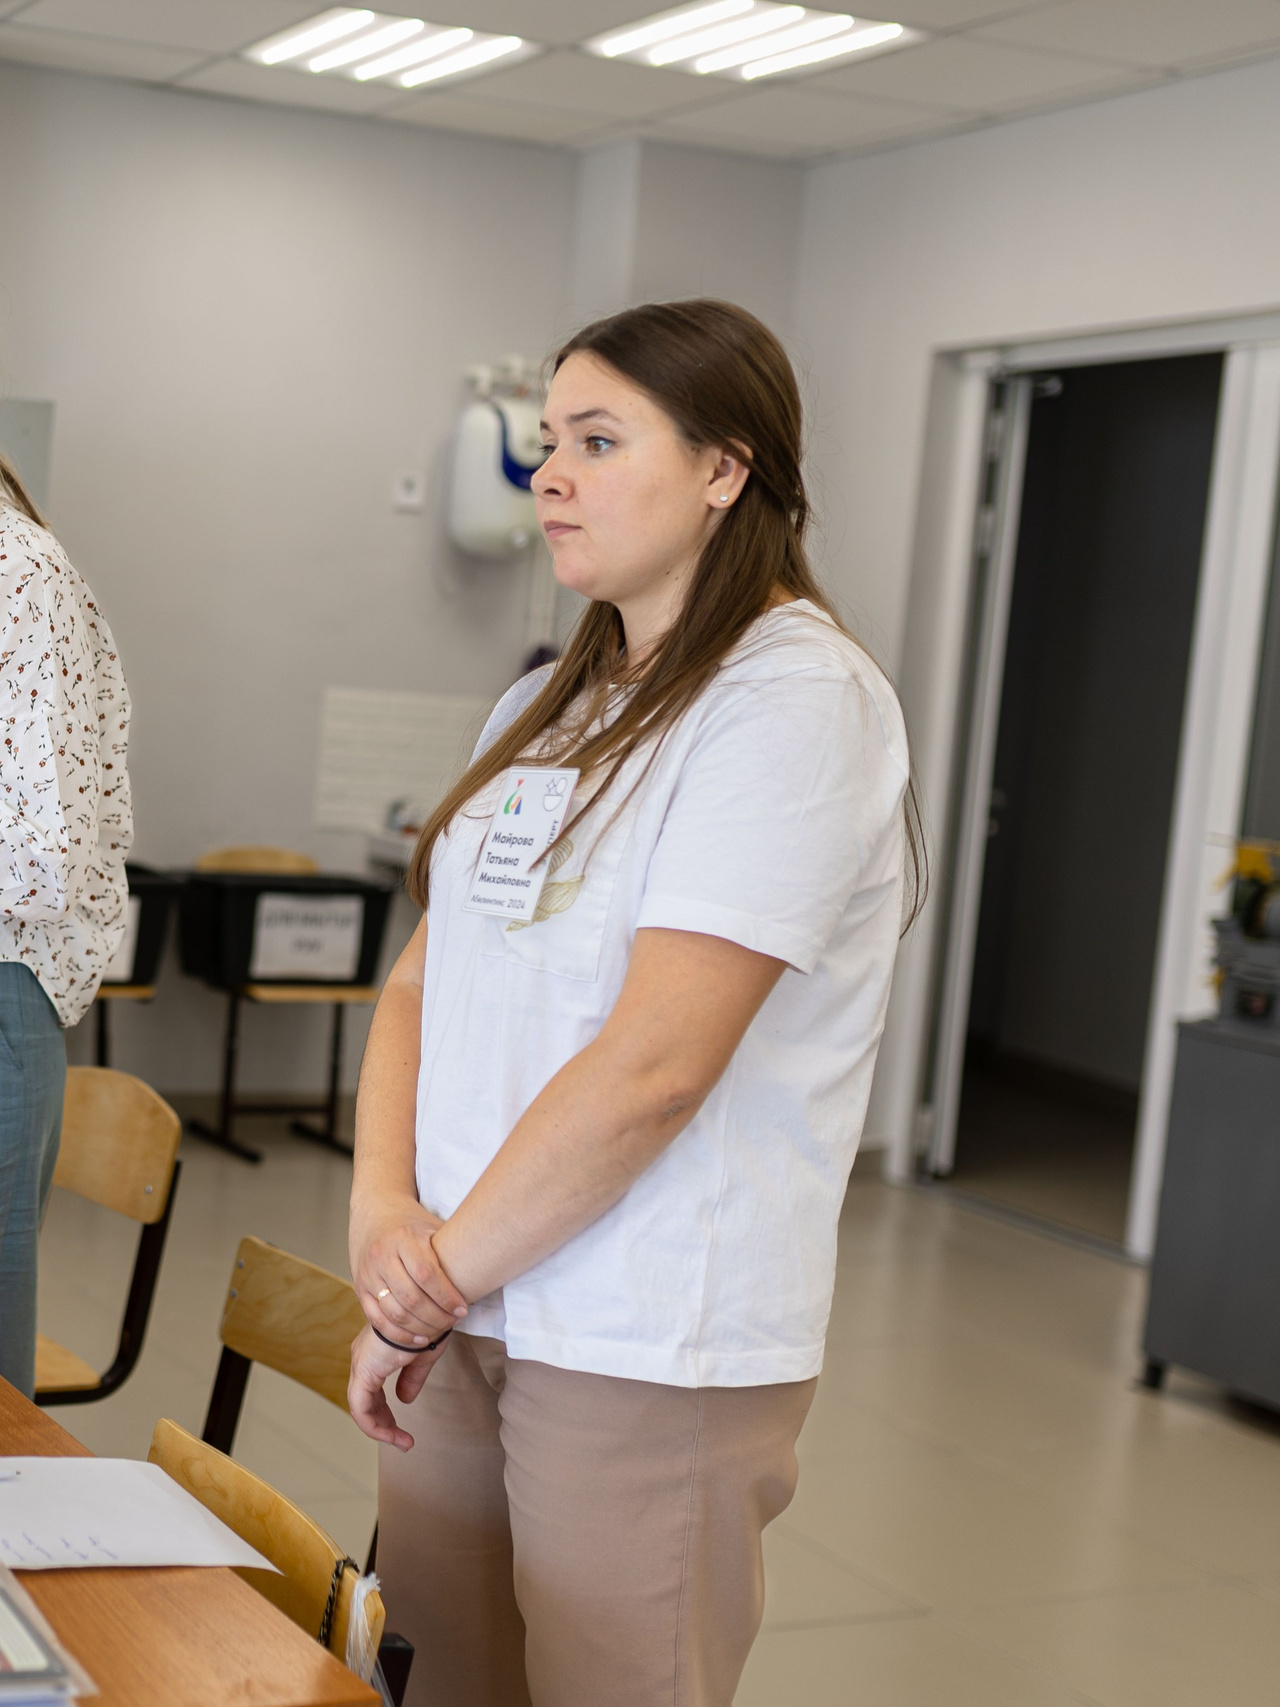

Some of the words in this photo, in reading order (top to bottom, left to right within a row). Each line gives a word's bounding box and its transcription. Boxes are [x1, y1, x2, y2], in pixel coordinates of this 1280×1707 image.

[492, 832, 534, 848] Майрова
[485, 852, 519, 866] Татьяна
[478, 872, 532, 888] Михайловна
[507, 899, 526, 910] 2024
